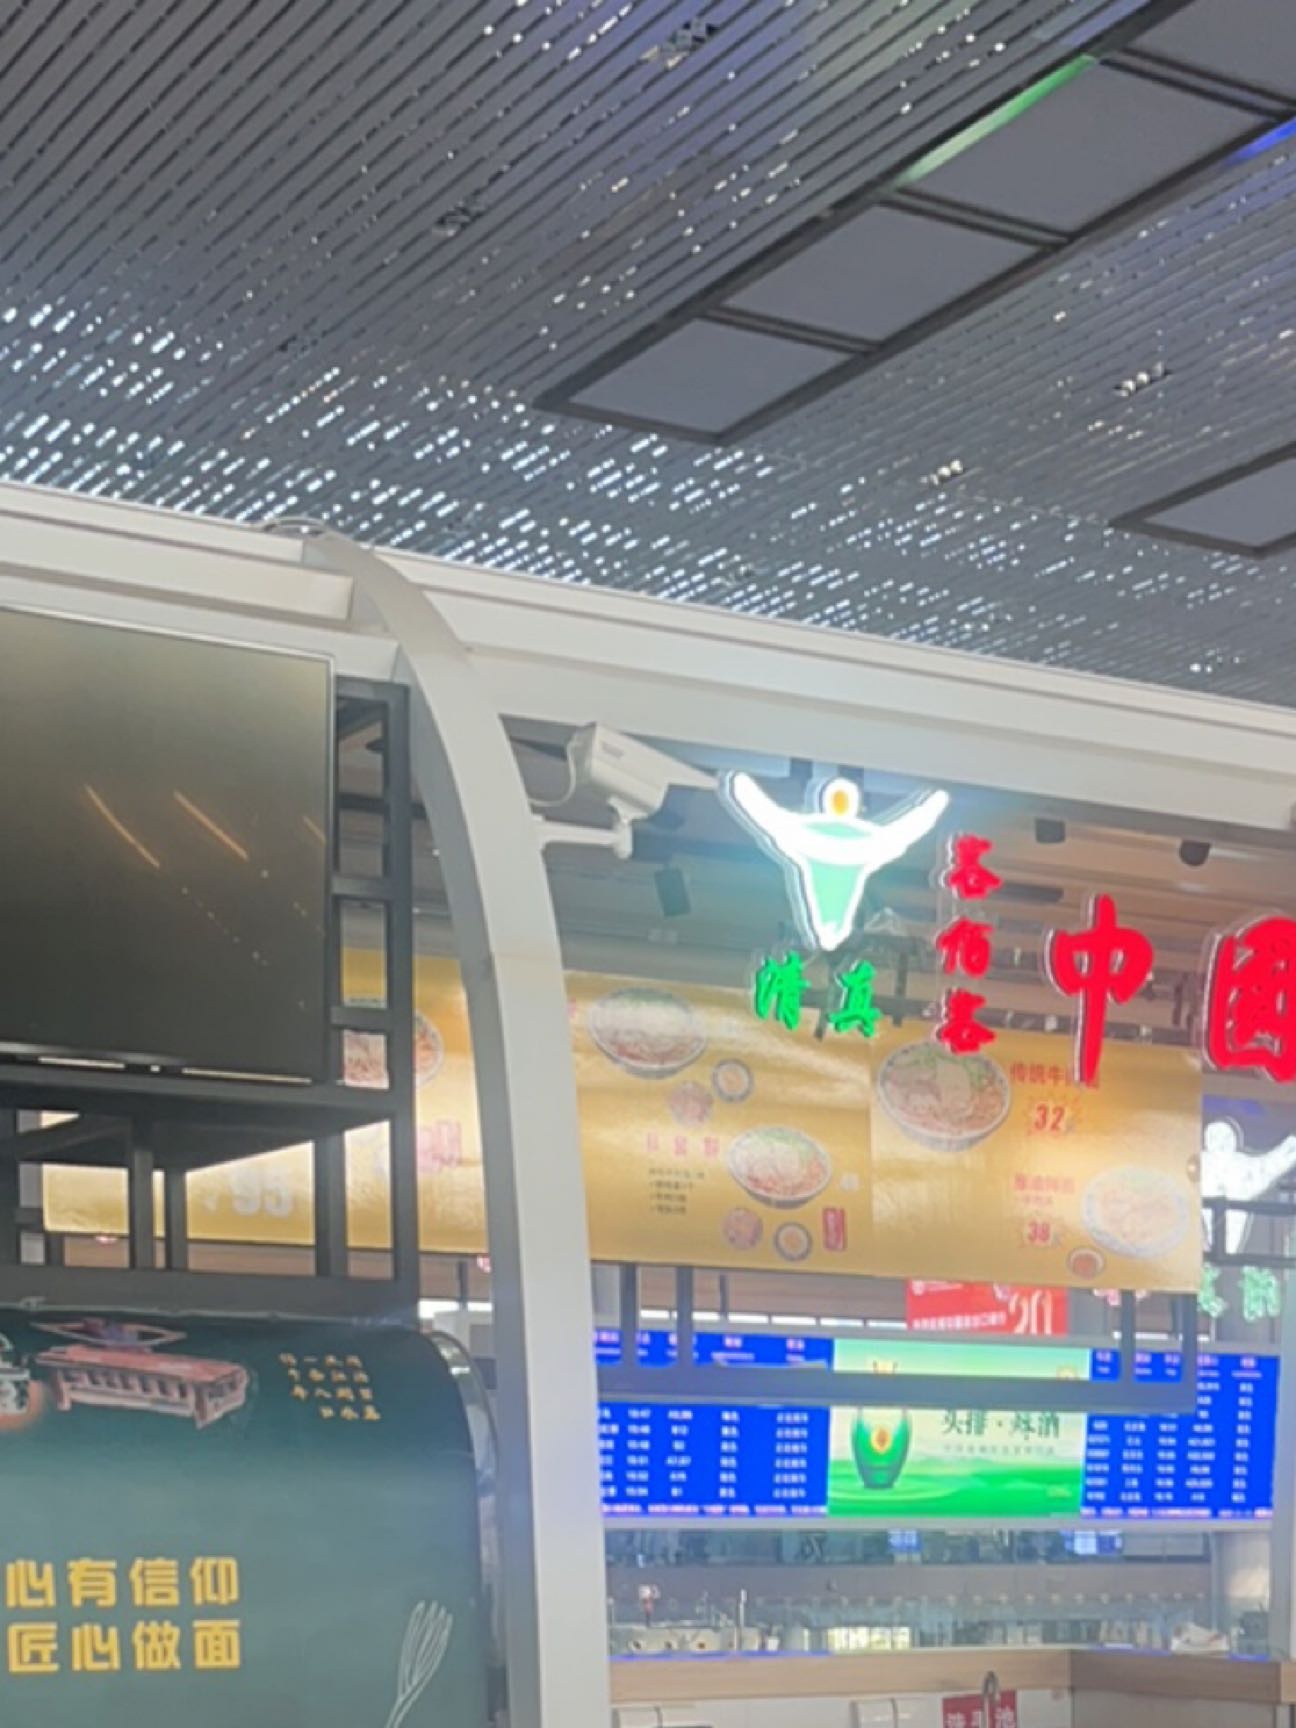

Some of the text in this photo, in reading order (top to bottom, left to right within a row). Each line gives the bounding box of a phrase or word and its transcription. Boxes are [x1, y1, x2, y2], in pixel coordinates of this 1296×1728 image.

[753, 951, 881, 1037] 清真
[1034, 1105, 1066, 1131] 32
[6, 1557, 240, 1606] 心有信仰
[8, 1620, 241, 1673] 匠心做面
